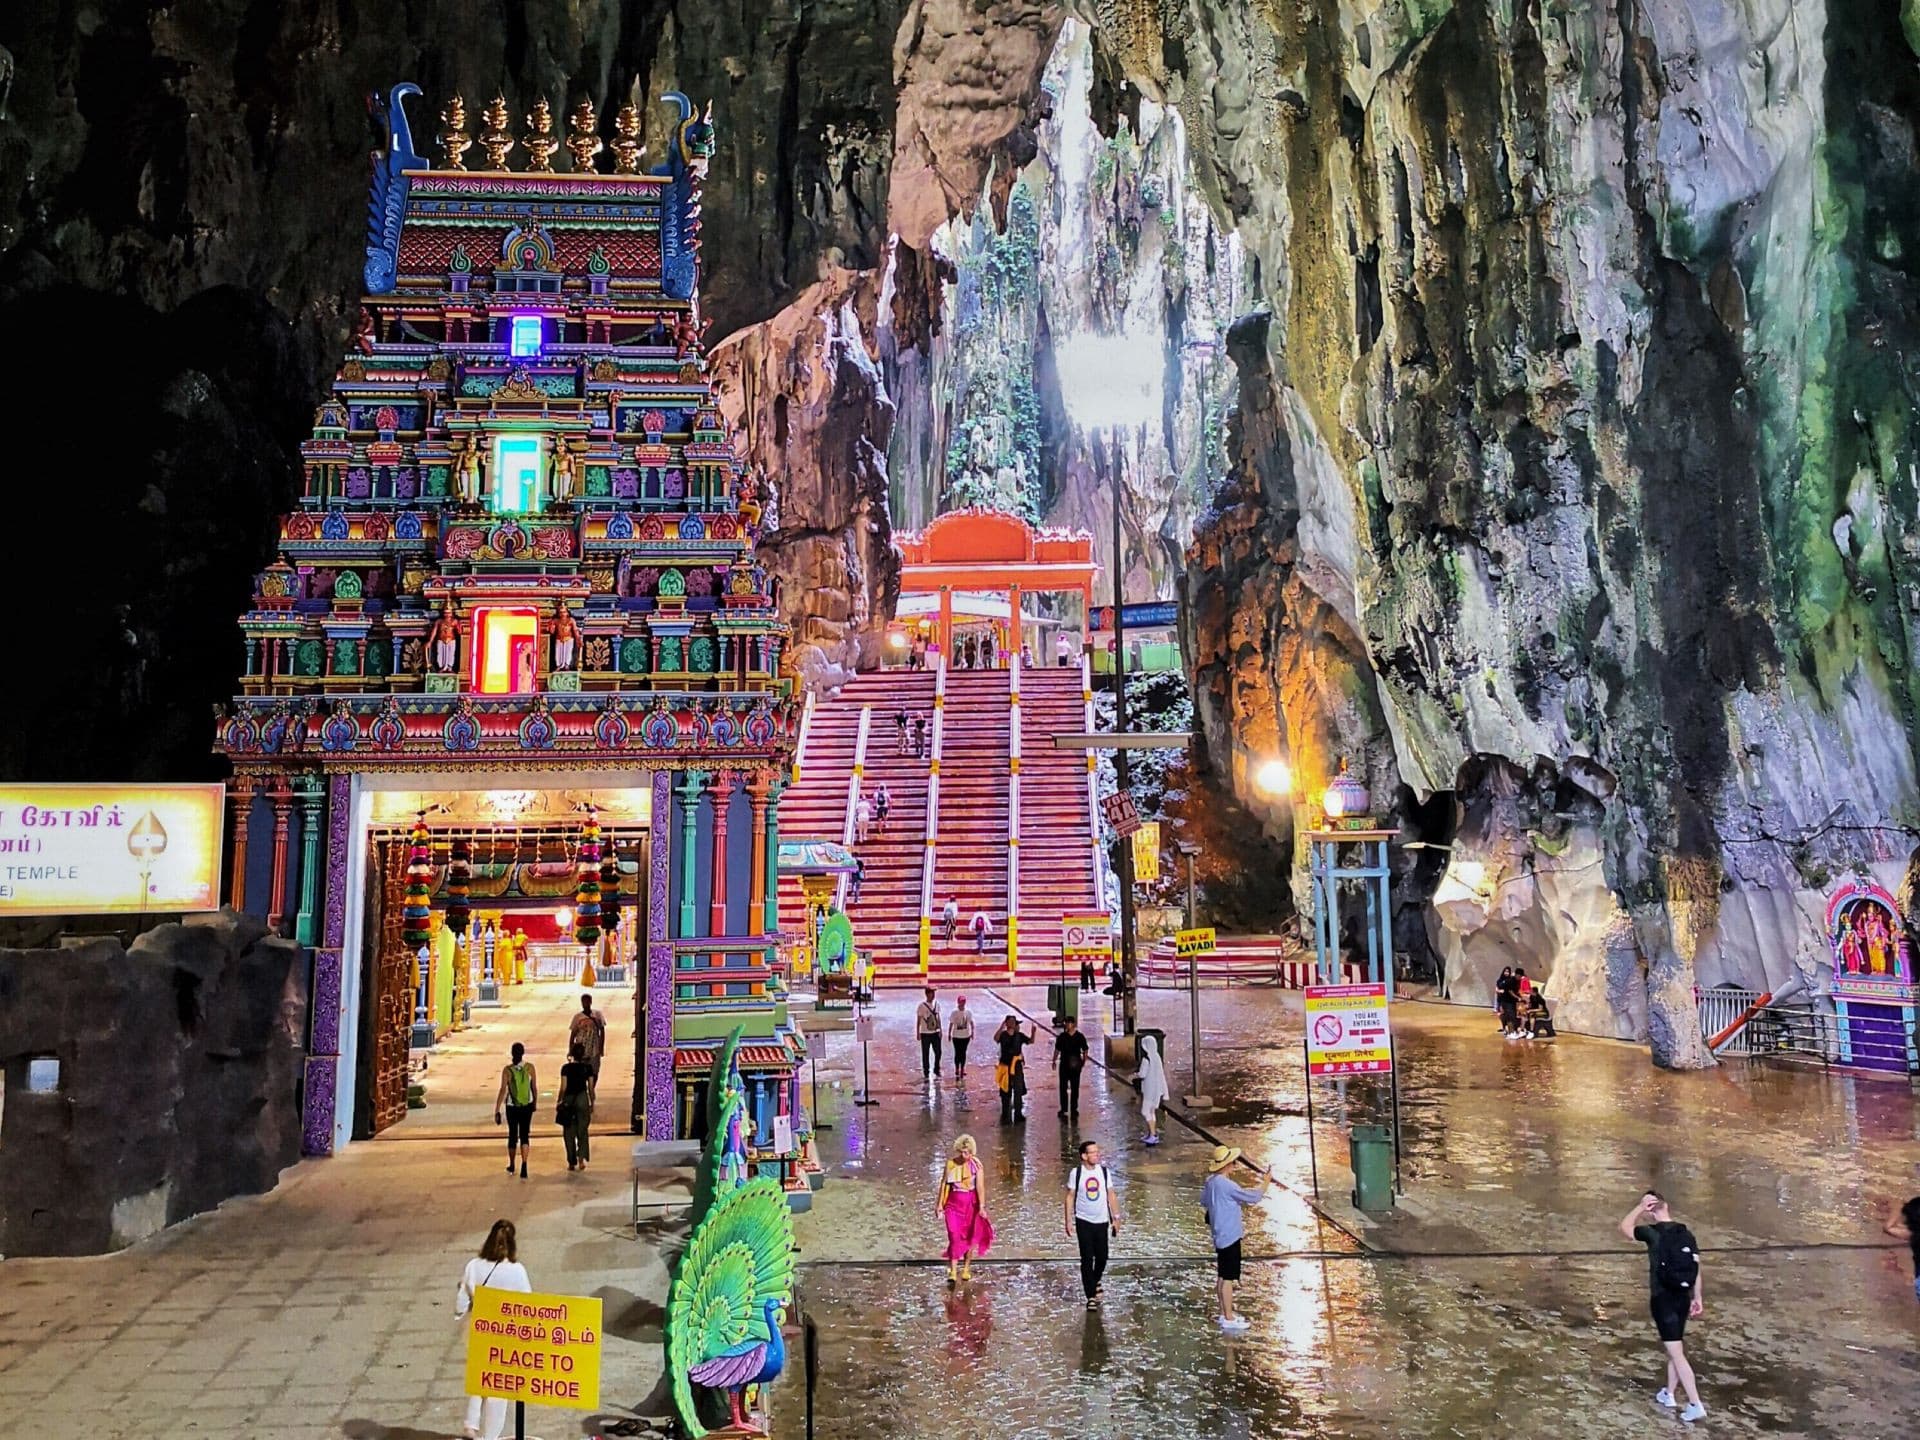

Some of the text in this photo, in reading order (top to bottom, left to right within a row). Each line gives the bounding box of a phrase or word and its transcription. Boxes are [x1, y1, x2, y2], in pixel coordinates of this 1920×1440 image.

[21, 804, 124, 828] கோவில்
[1110, 801, 1136, 821] 4A
[6, 866, 79, 880] TEMPLE
[1178, 941, 1214, 954] KAVADI
[501, 1302, 568, 1321] காலணி
[474, 1319, 595, 1345] வைக்கும் இடம்
[489, 1347, 574, 1372] PLACE TO
[481, 1371, 580, 1398] KEEP SHOE
